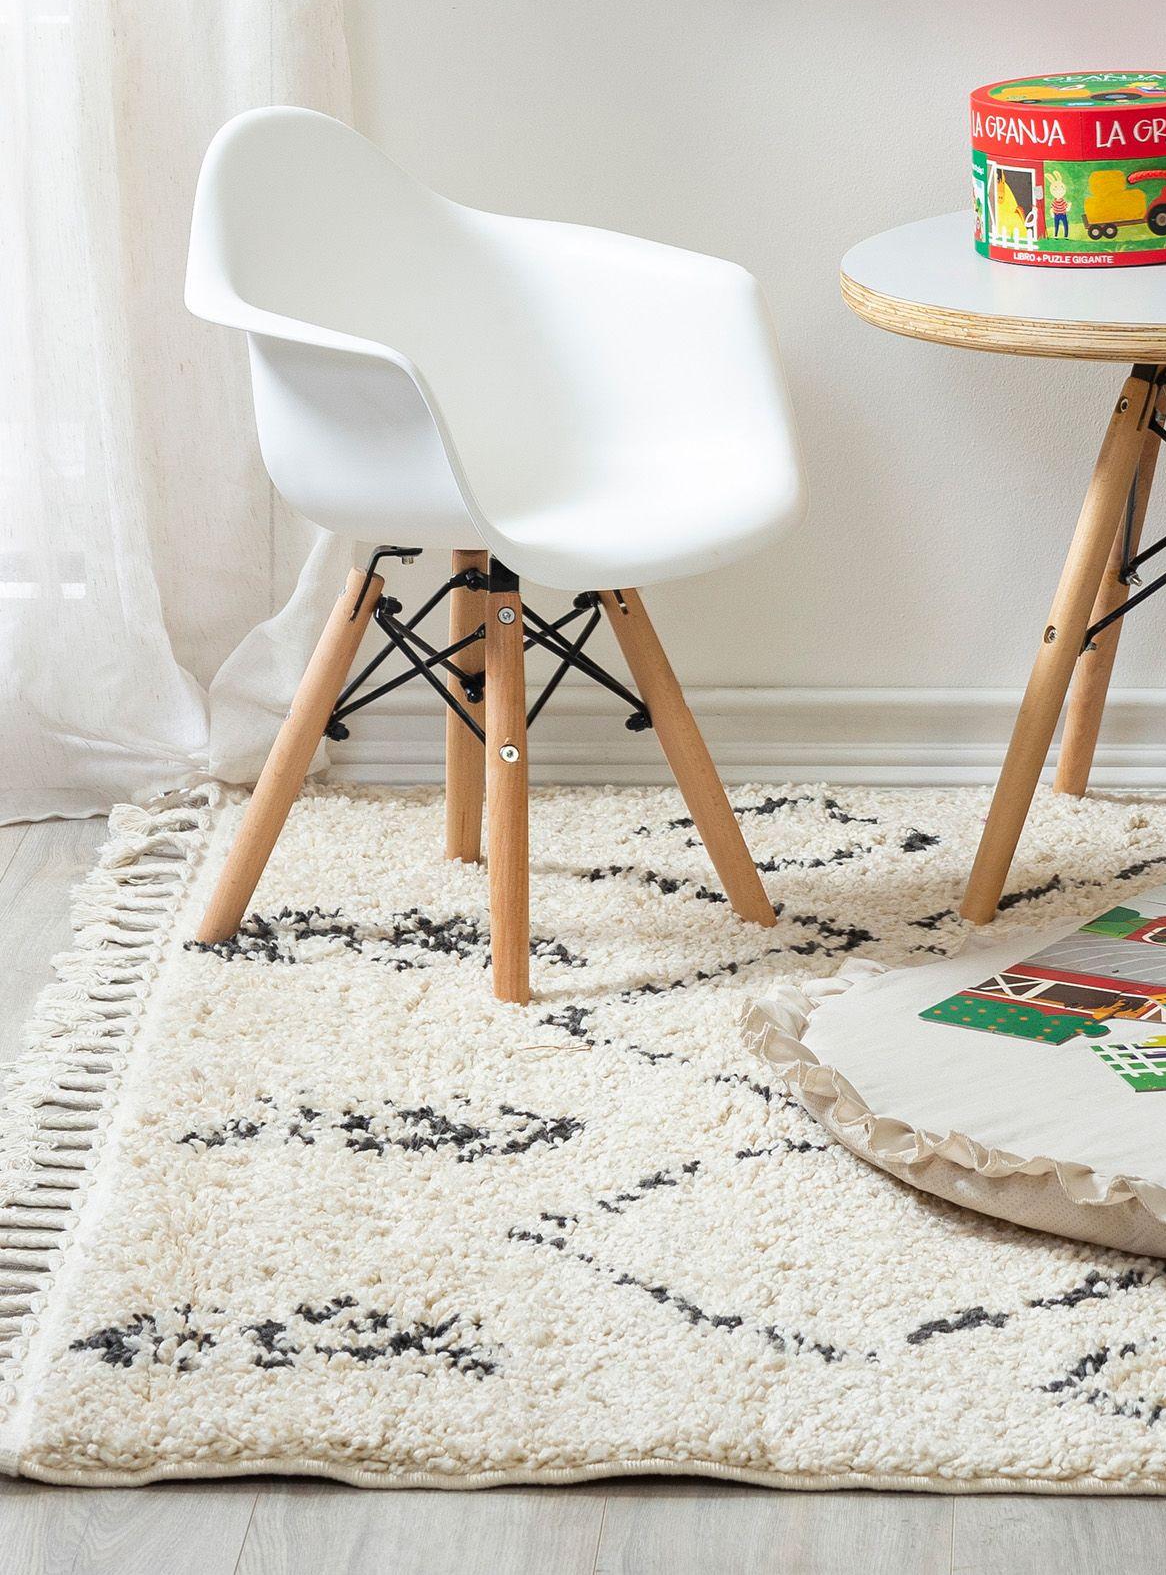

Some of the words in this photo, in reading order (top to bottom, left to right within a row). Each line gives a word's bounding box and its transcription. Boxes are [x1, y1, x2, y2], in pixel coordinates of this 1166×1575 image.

[984, 115, 1066, 146] GRANJA
[1095, 121, 1126, 148] LA
[1072, 255, 1114, 264] GIGANTE
